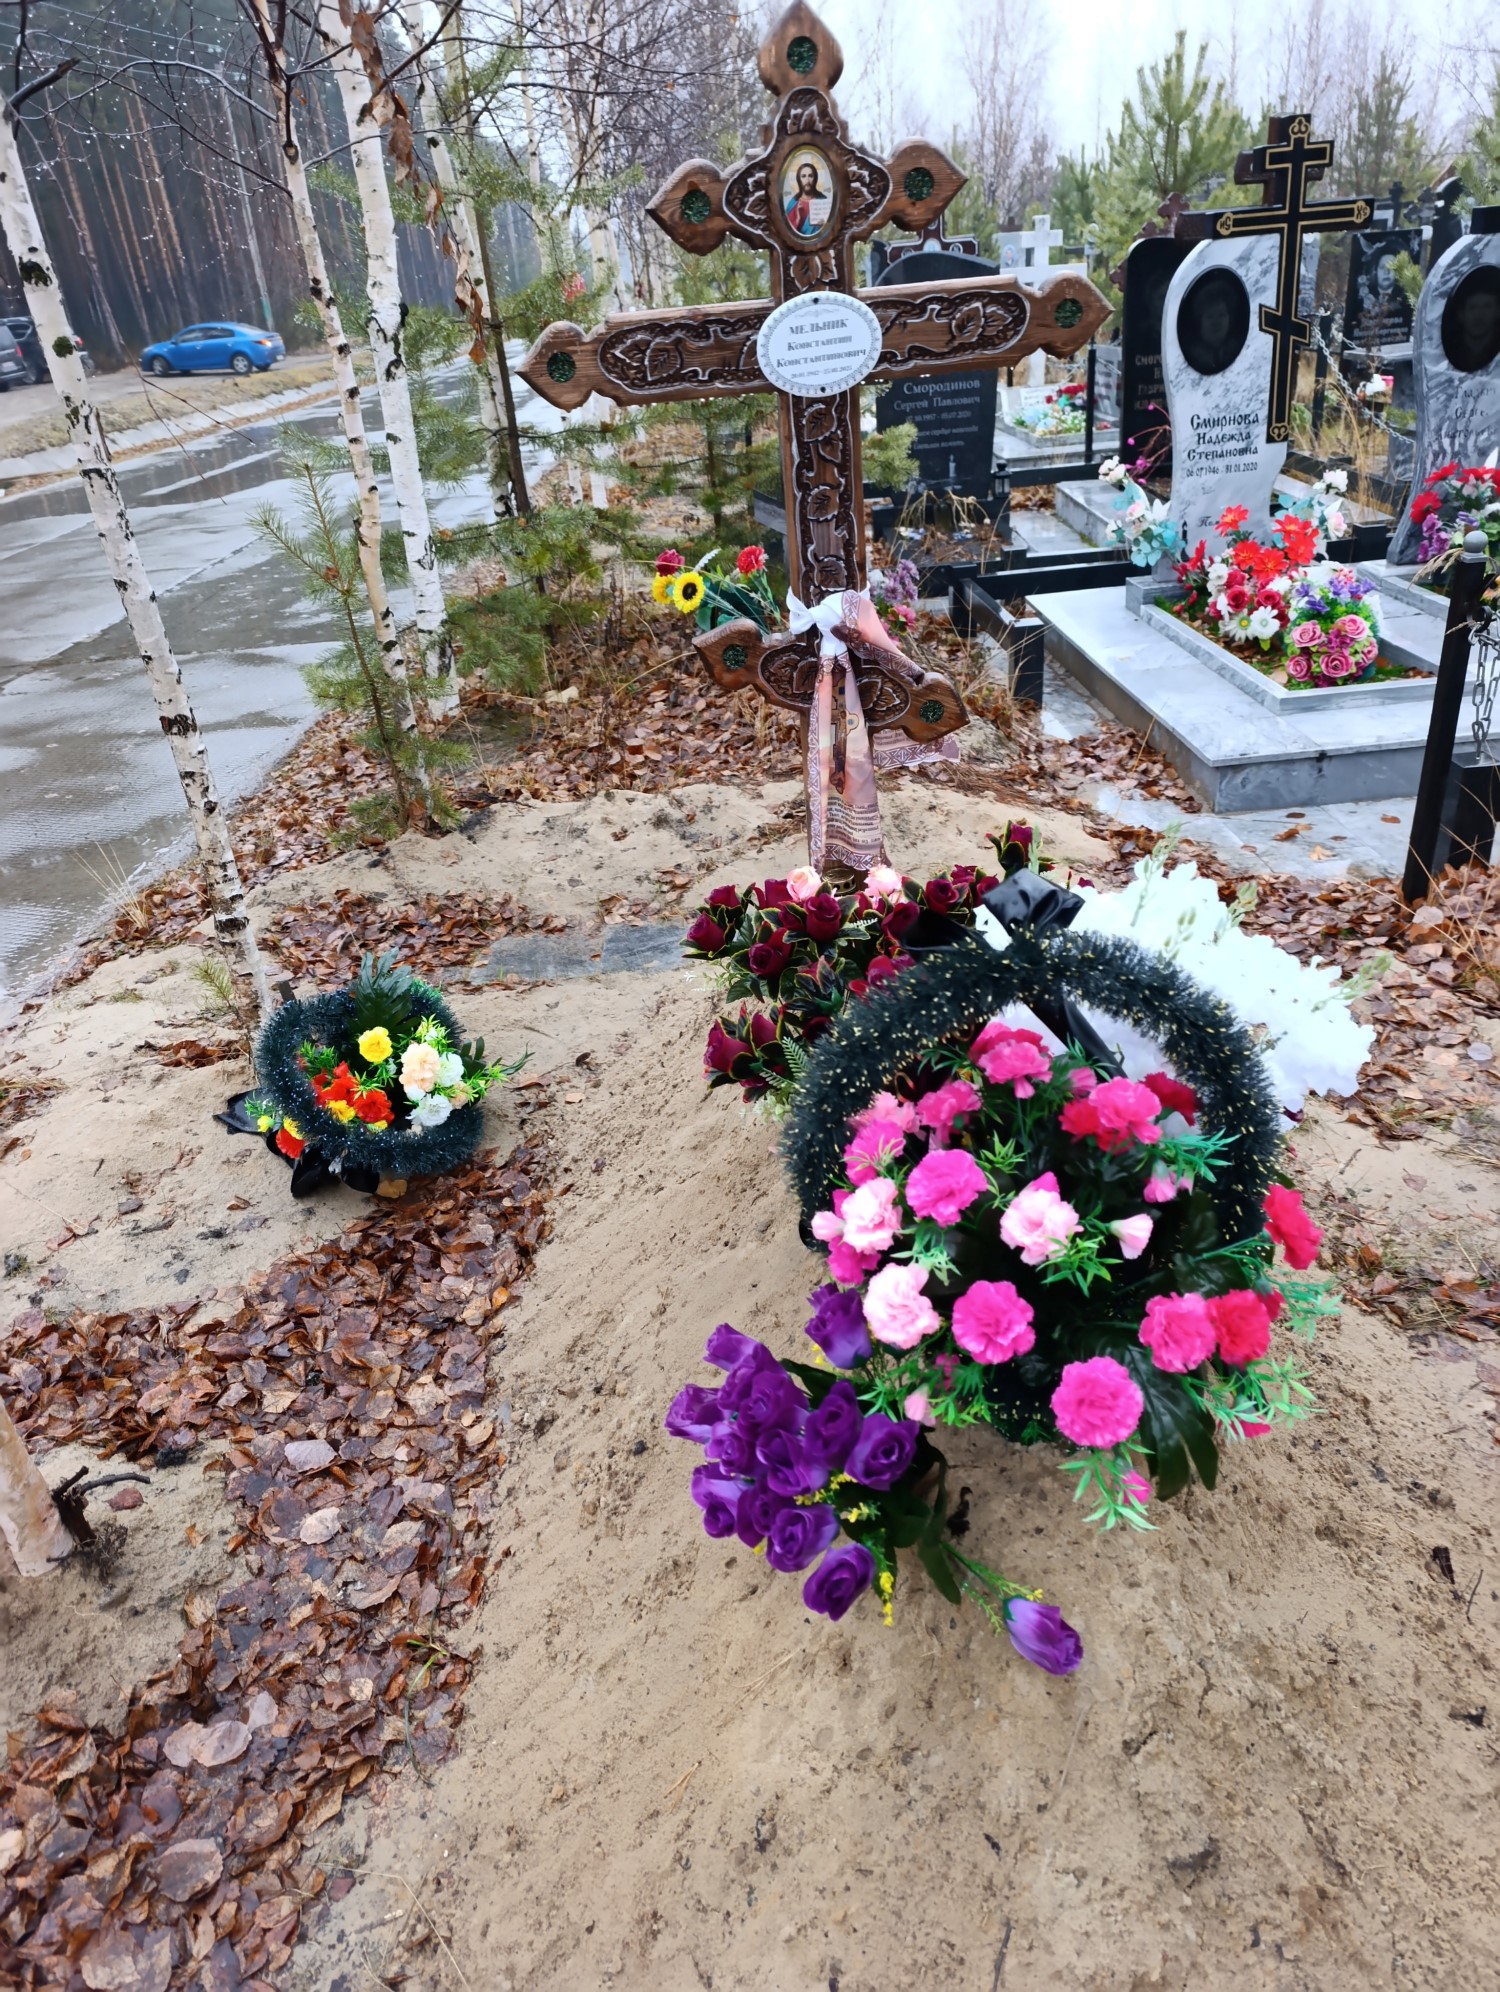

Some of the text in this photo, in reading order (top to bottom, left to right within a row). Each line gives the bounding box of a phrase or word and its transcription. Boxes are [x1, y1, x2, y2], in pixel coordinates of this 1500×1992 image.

[789, 318, 849, 335] МЕЛЬНИК
[903, 380, 980, 396] Смородинов
[893, 395, 980, 412] Сергей Павлович
[1190, 413, 1260, 432] Смирнова
[1197, 431, 1252, 446] Надежда
[1187, 446, 1259, 462] Степановна
